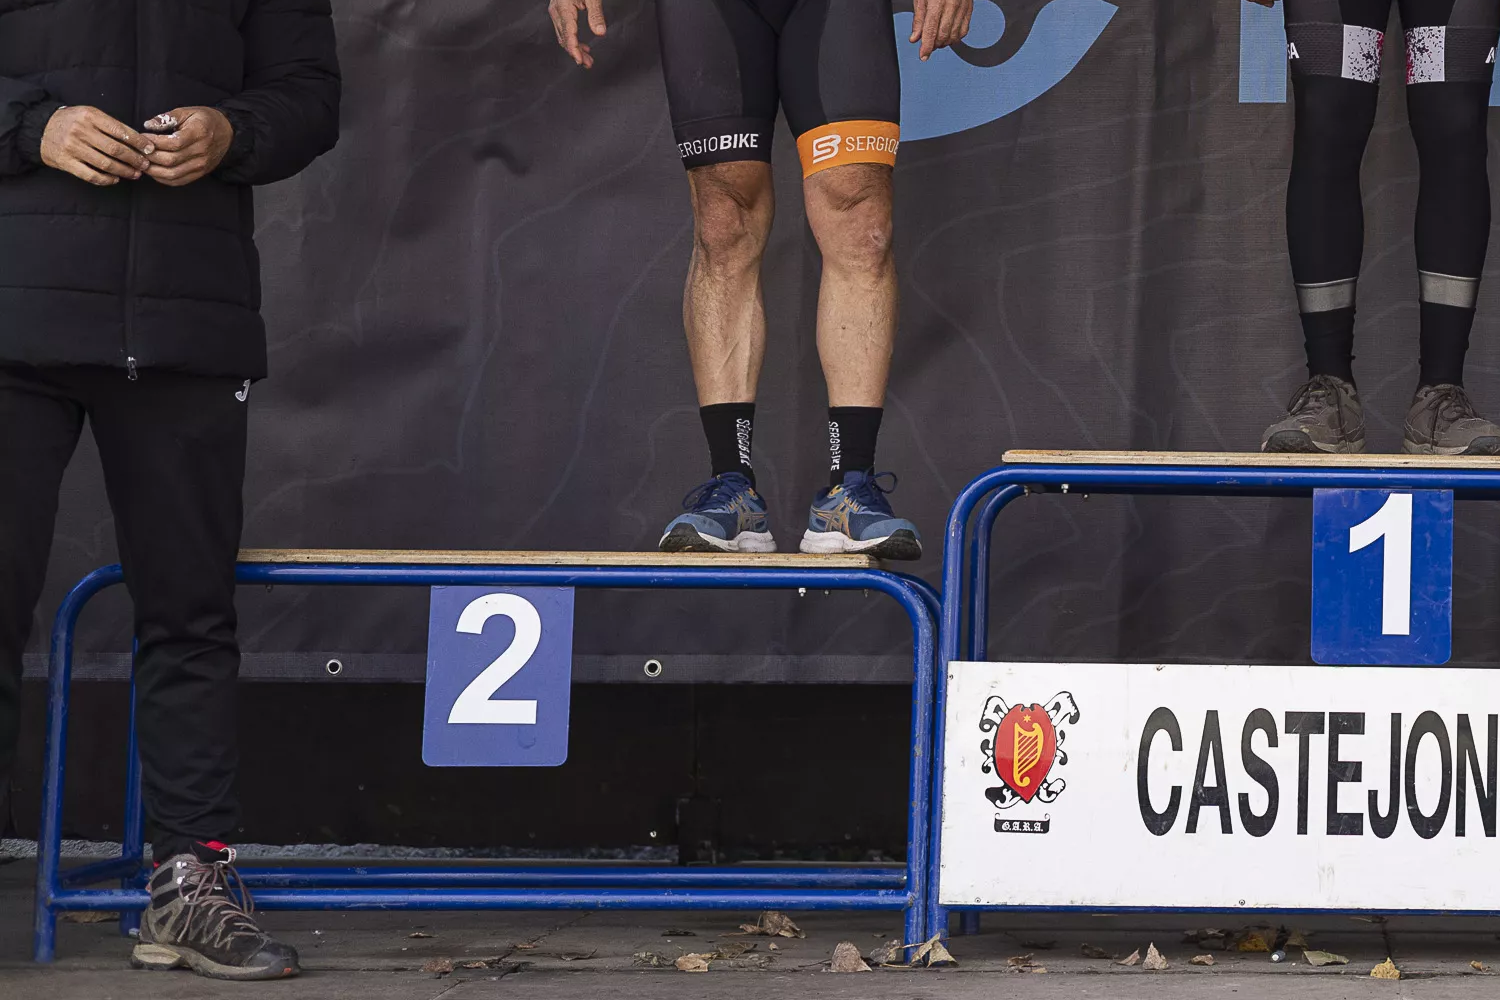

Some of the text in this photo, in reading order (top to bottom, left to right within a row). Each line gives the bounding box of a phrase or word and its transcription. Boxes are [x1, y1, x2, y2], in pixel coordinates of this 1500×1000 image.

[1349, 493, 1412, 635] 1
[448, 593, 541, 724] 2
[1137, 707, 1498, 839] CASTEJON
